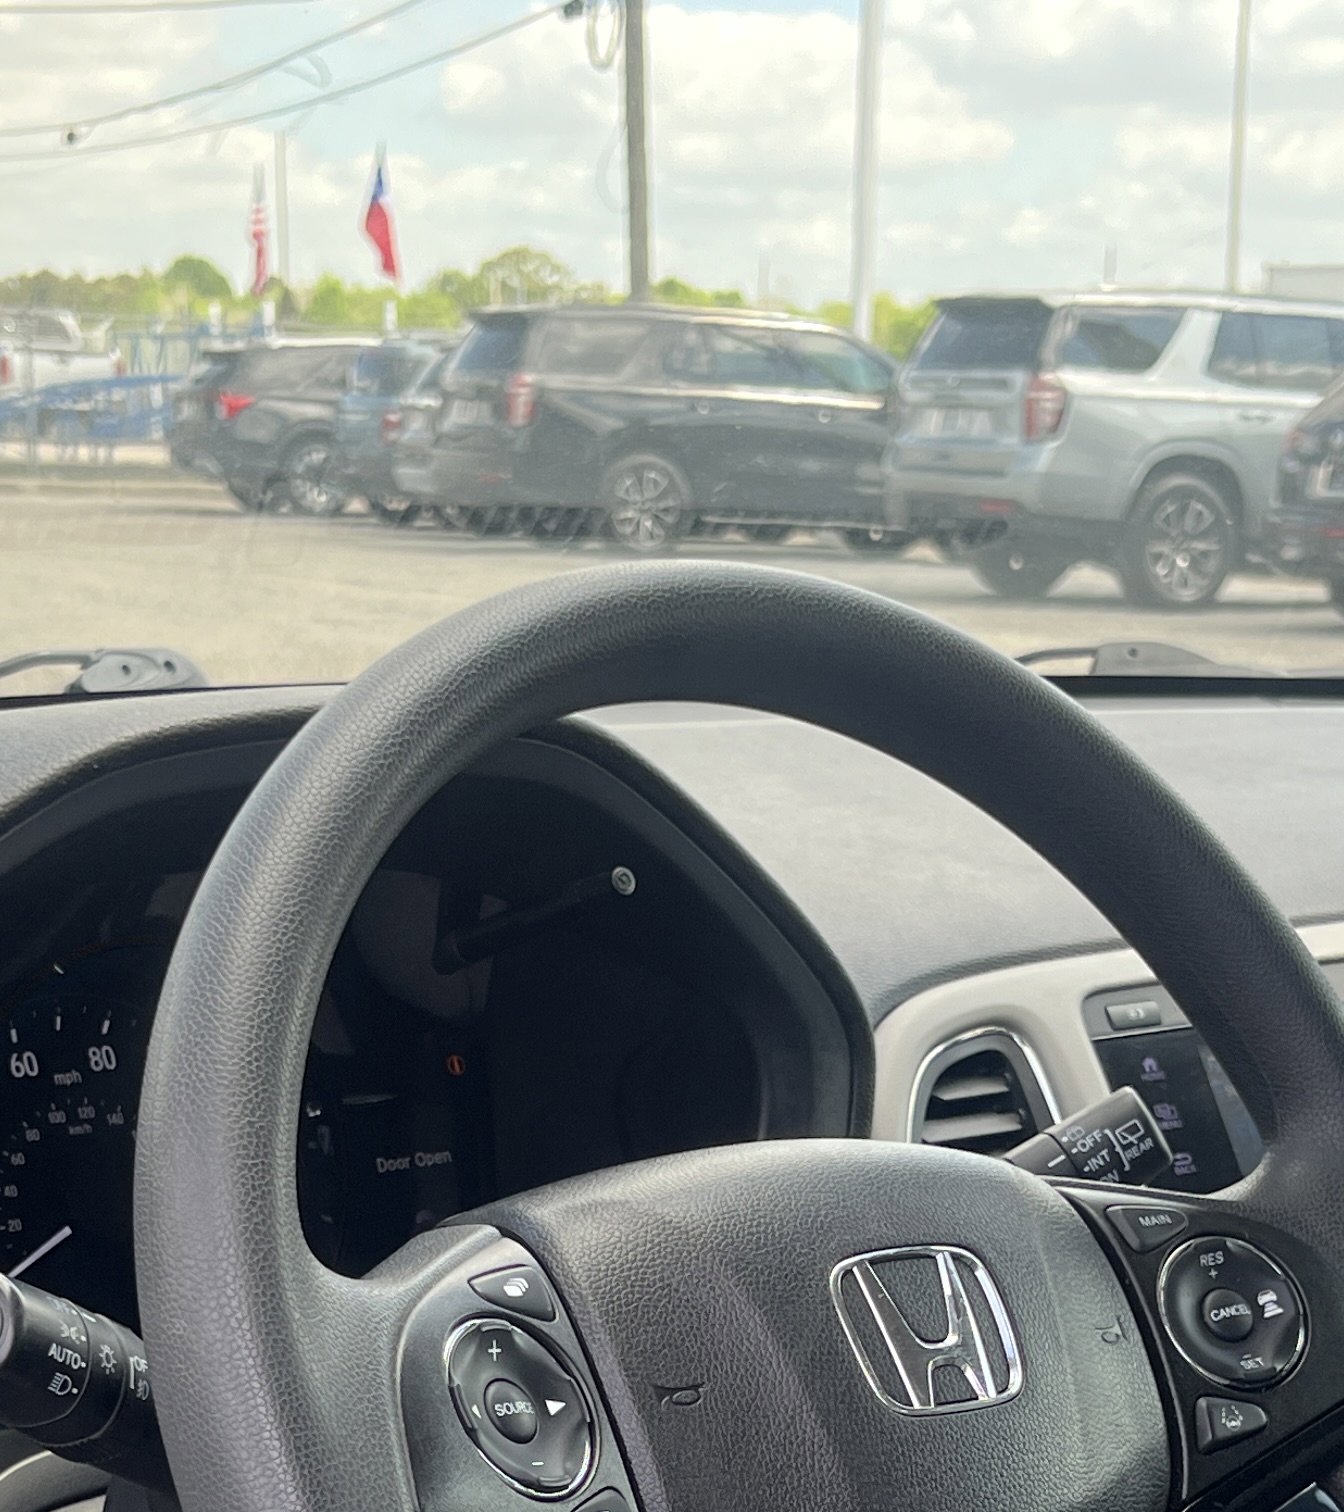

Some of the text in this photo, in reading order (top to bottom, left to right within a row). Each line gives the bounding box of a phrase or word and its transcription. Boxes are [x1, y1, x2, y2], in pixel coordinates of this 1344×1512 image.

[10, 1051, 39, 1078] 60
[87, 1046, 117, 1072] 80
[53, 1069, 83, 1087] mph
[47, 1111, 67, 1125] 100
[78, 1105, 96, 1120] 120
[107, 1112, 124, 1127] 140
[25, 1128, 41, 1143] 80
[68, 1123, 93, 1136] km/h
[1076, 1129, 1103, 1153] OFF
[1124, 1137, 1154, 1161] REAR
[10, 1152, 25, 1166] 60
[376, 1149, 452, 1175] Door Open
[1087, 1148, 1111, 1172] INT
[4, 1184, 18, 1198] 40
[8, 1218, 22, 1233] 20
[1138, 1214, 1173, 1227] MAIN
[1199, 1251, 1224, 1267] RES
[1210, 1304, 1252, 1322] CANCEL
[47, 1342, 82, 1371] AUTO
[1239, 1356, 1265, 1371] SET
[494, 1401, 535, 1418] SOURCE
